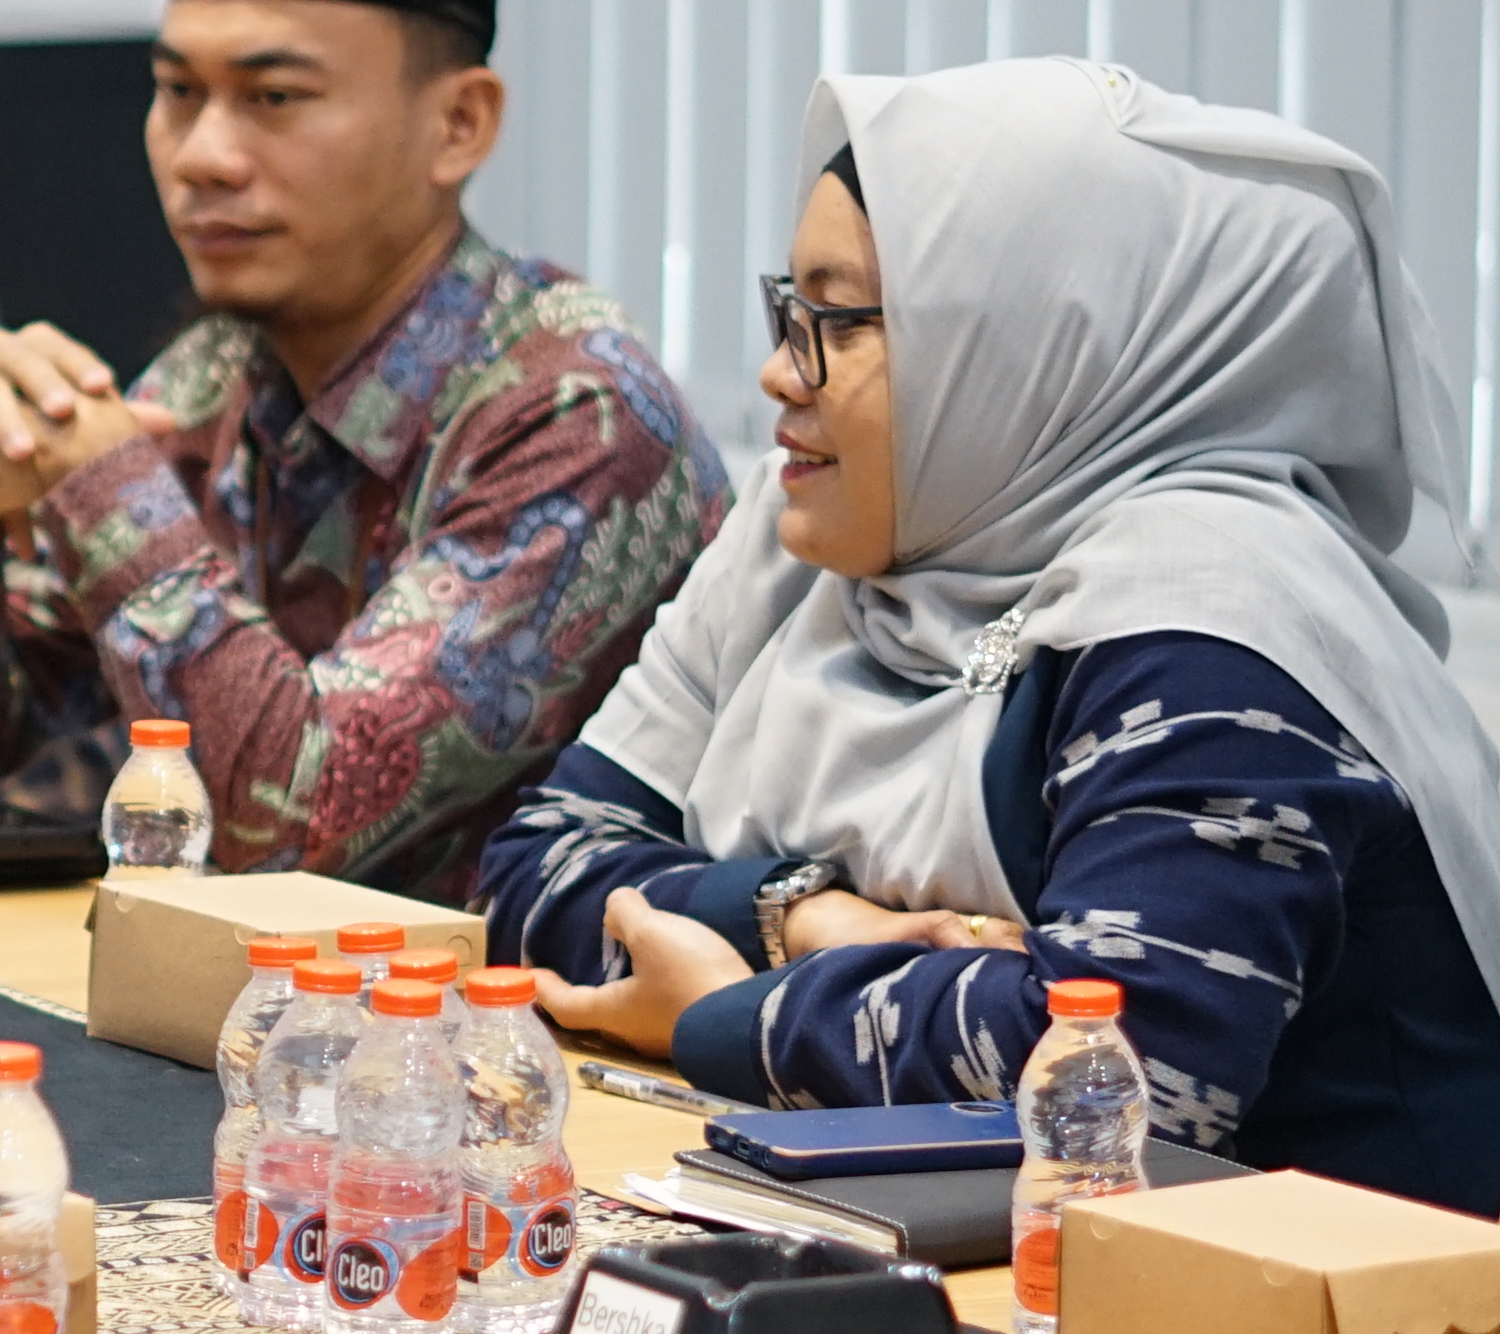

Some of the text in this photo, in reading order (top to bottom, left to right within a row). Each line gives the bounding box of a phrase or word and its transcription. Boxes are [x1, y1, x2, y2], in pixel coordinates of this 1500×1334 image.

[301, 1229, 325, 1262] Cl
[534, 1222, 572, 1255] Cleo
[337, 1253, 385, 1292] Cleo
